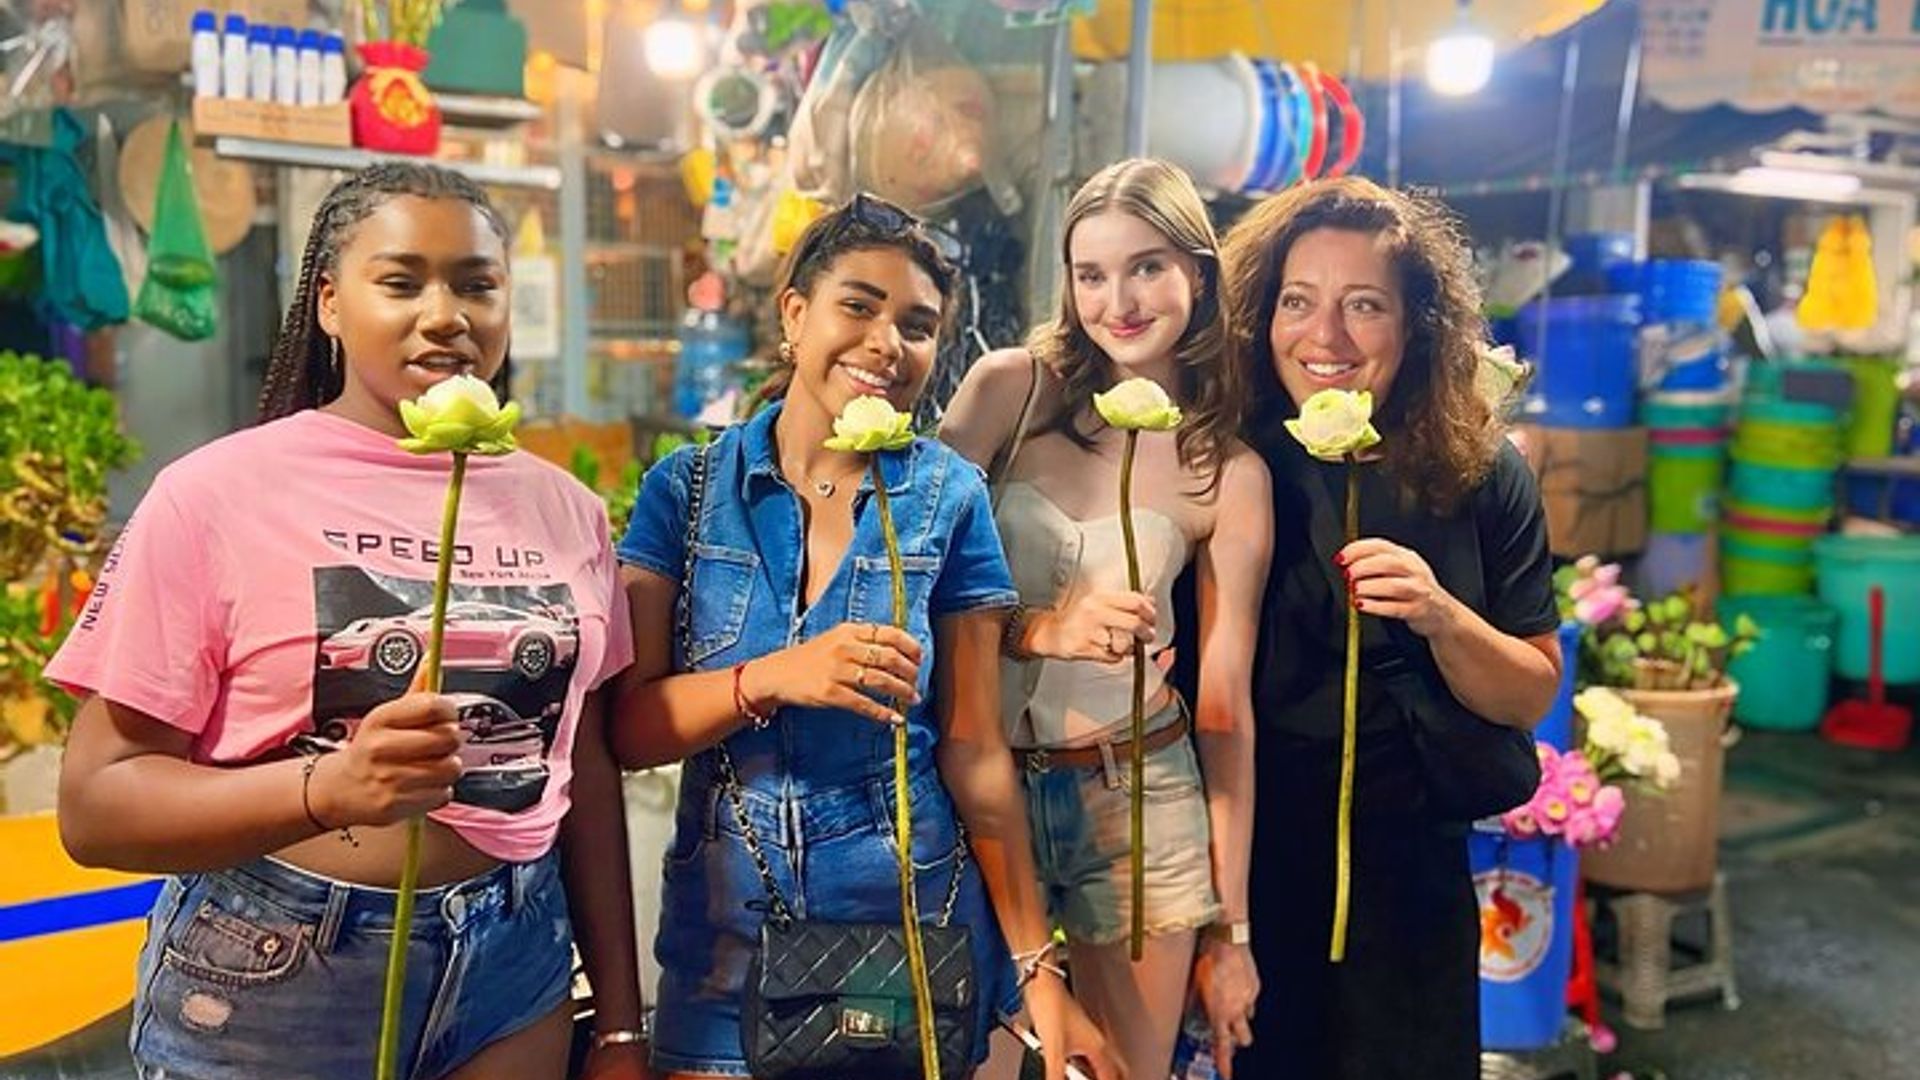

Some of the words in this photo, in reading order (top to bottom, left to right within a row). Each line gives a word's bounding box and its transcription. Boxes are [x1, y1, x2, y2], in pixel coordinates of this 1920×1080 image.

[323, 529, 473, 566] SPEED
[496, 546, 544, 567] UP
[80, 582, 110, 631] NEW
